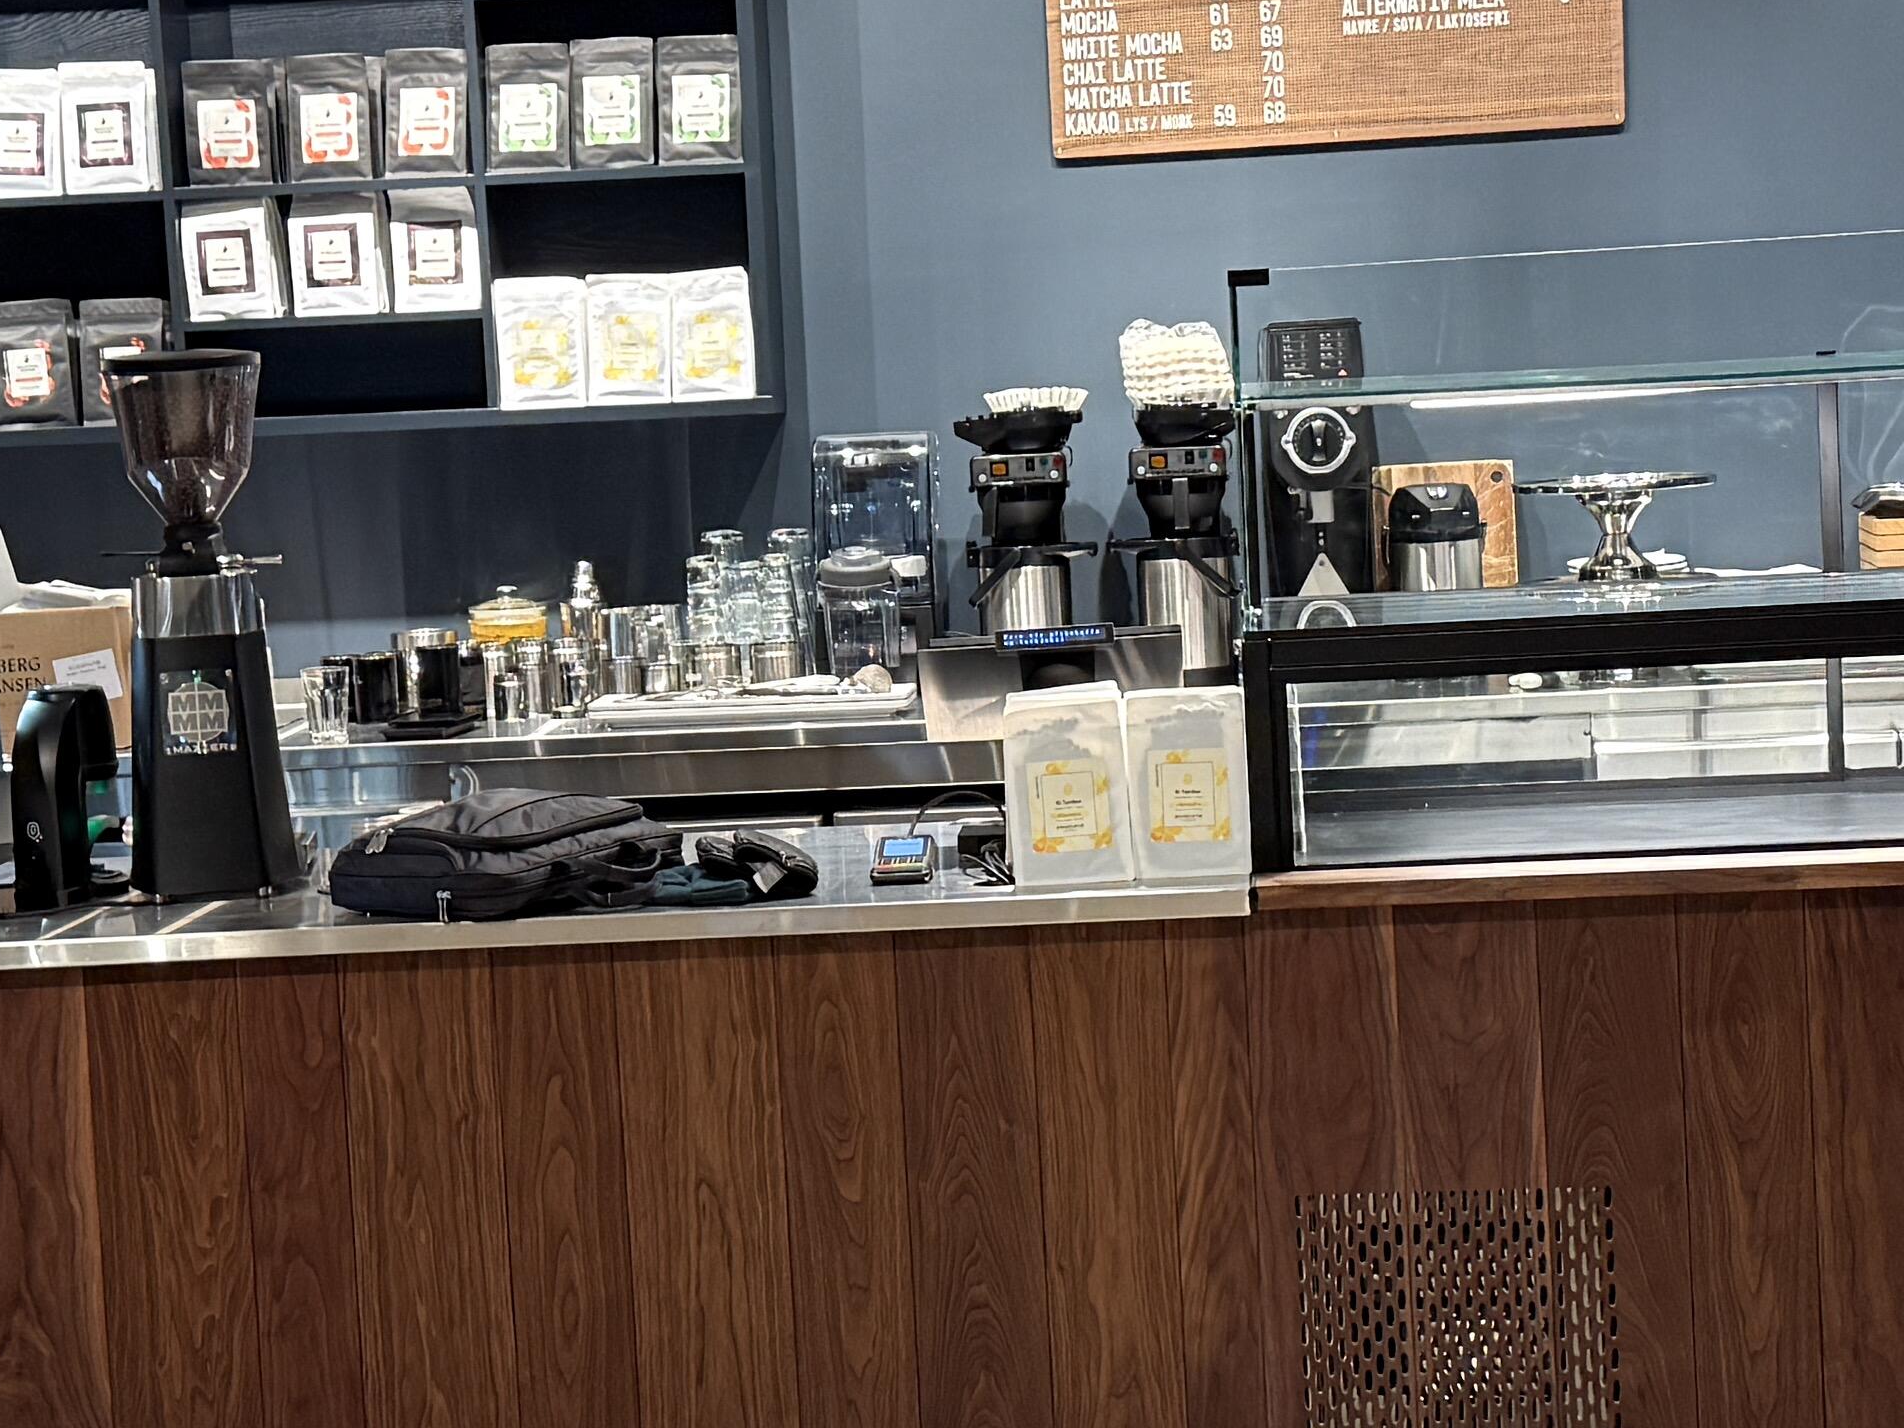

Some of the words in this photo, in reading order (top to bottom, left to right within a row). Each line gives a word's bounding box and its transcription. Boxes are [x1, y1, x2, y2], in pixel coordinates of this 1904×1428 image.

[1061, 10, 1118, 35] MOCHA
[1209, 3, 1229, 25] 61
[1259, 0, 1282, 22] 67
[1343, 19, 1380, 36] HAVRE
[1383, 17, 1390, 32] /
[1393, 15, 1423, 32] SOYA
[1426, 15, 1433, 29] /
[1436, 10, 1510, 29] LAKTOSEFRI
[1062, 35, 1119, 60] WHITE
[1126, 31, 1183, 57] MOCHA
[1211, 28, 1232, 52] 63
[1260, 25, 1283, 47] 69
[1063, 61, 1106, 86] CHAI
[1113, 58, 1167, 82] LATTE
[1261, 51, 1283, 73] 70
[1064, 85, 1132, 111] MATCHA
[1138, 81, 1193, 107] LATTE
[1262, 76, 1284, 98] 70
[1065, 111, 1119, 136] KAKAO
[1126, 117, 1148, 132] LYS
[1214, 104, 1236, 127] 59
[1264, 101, 1286, 124] 68
